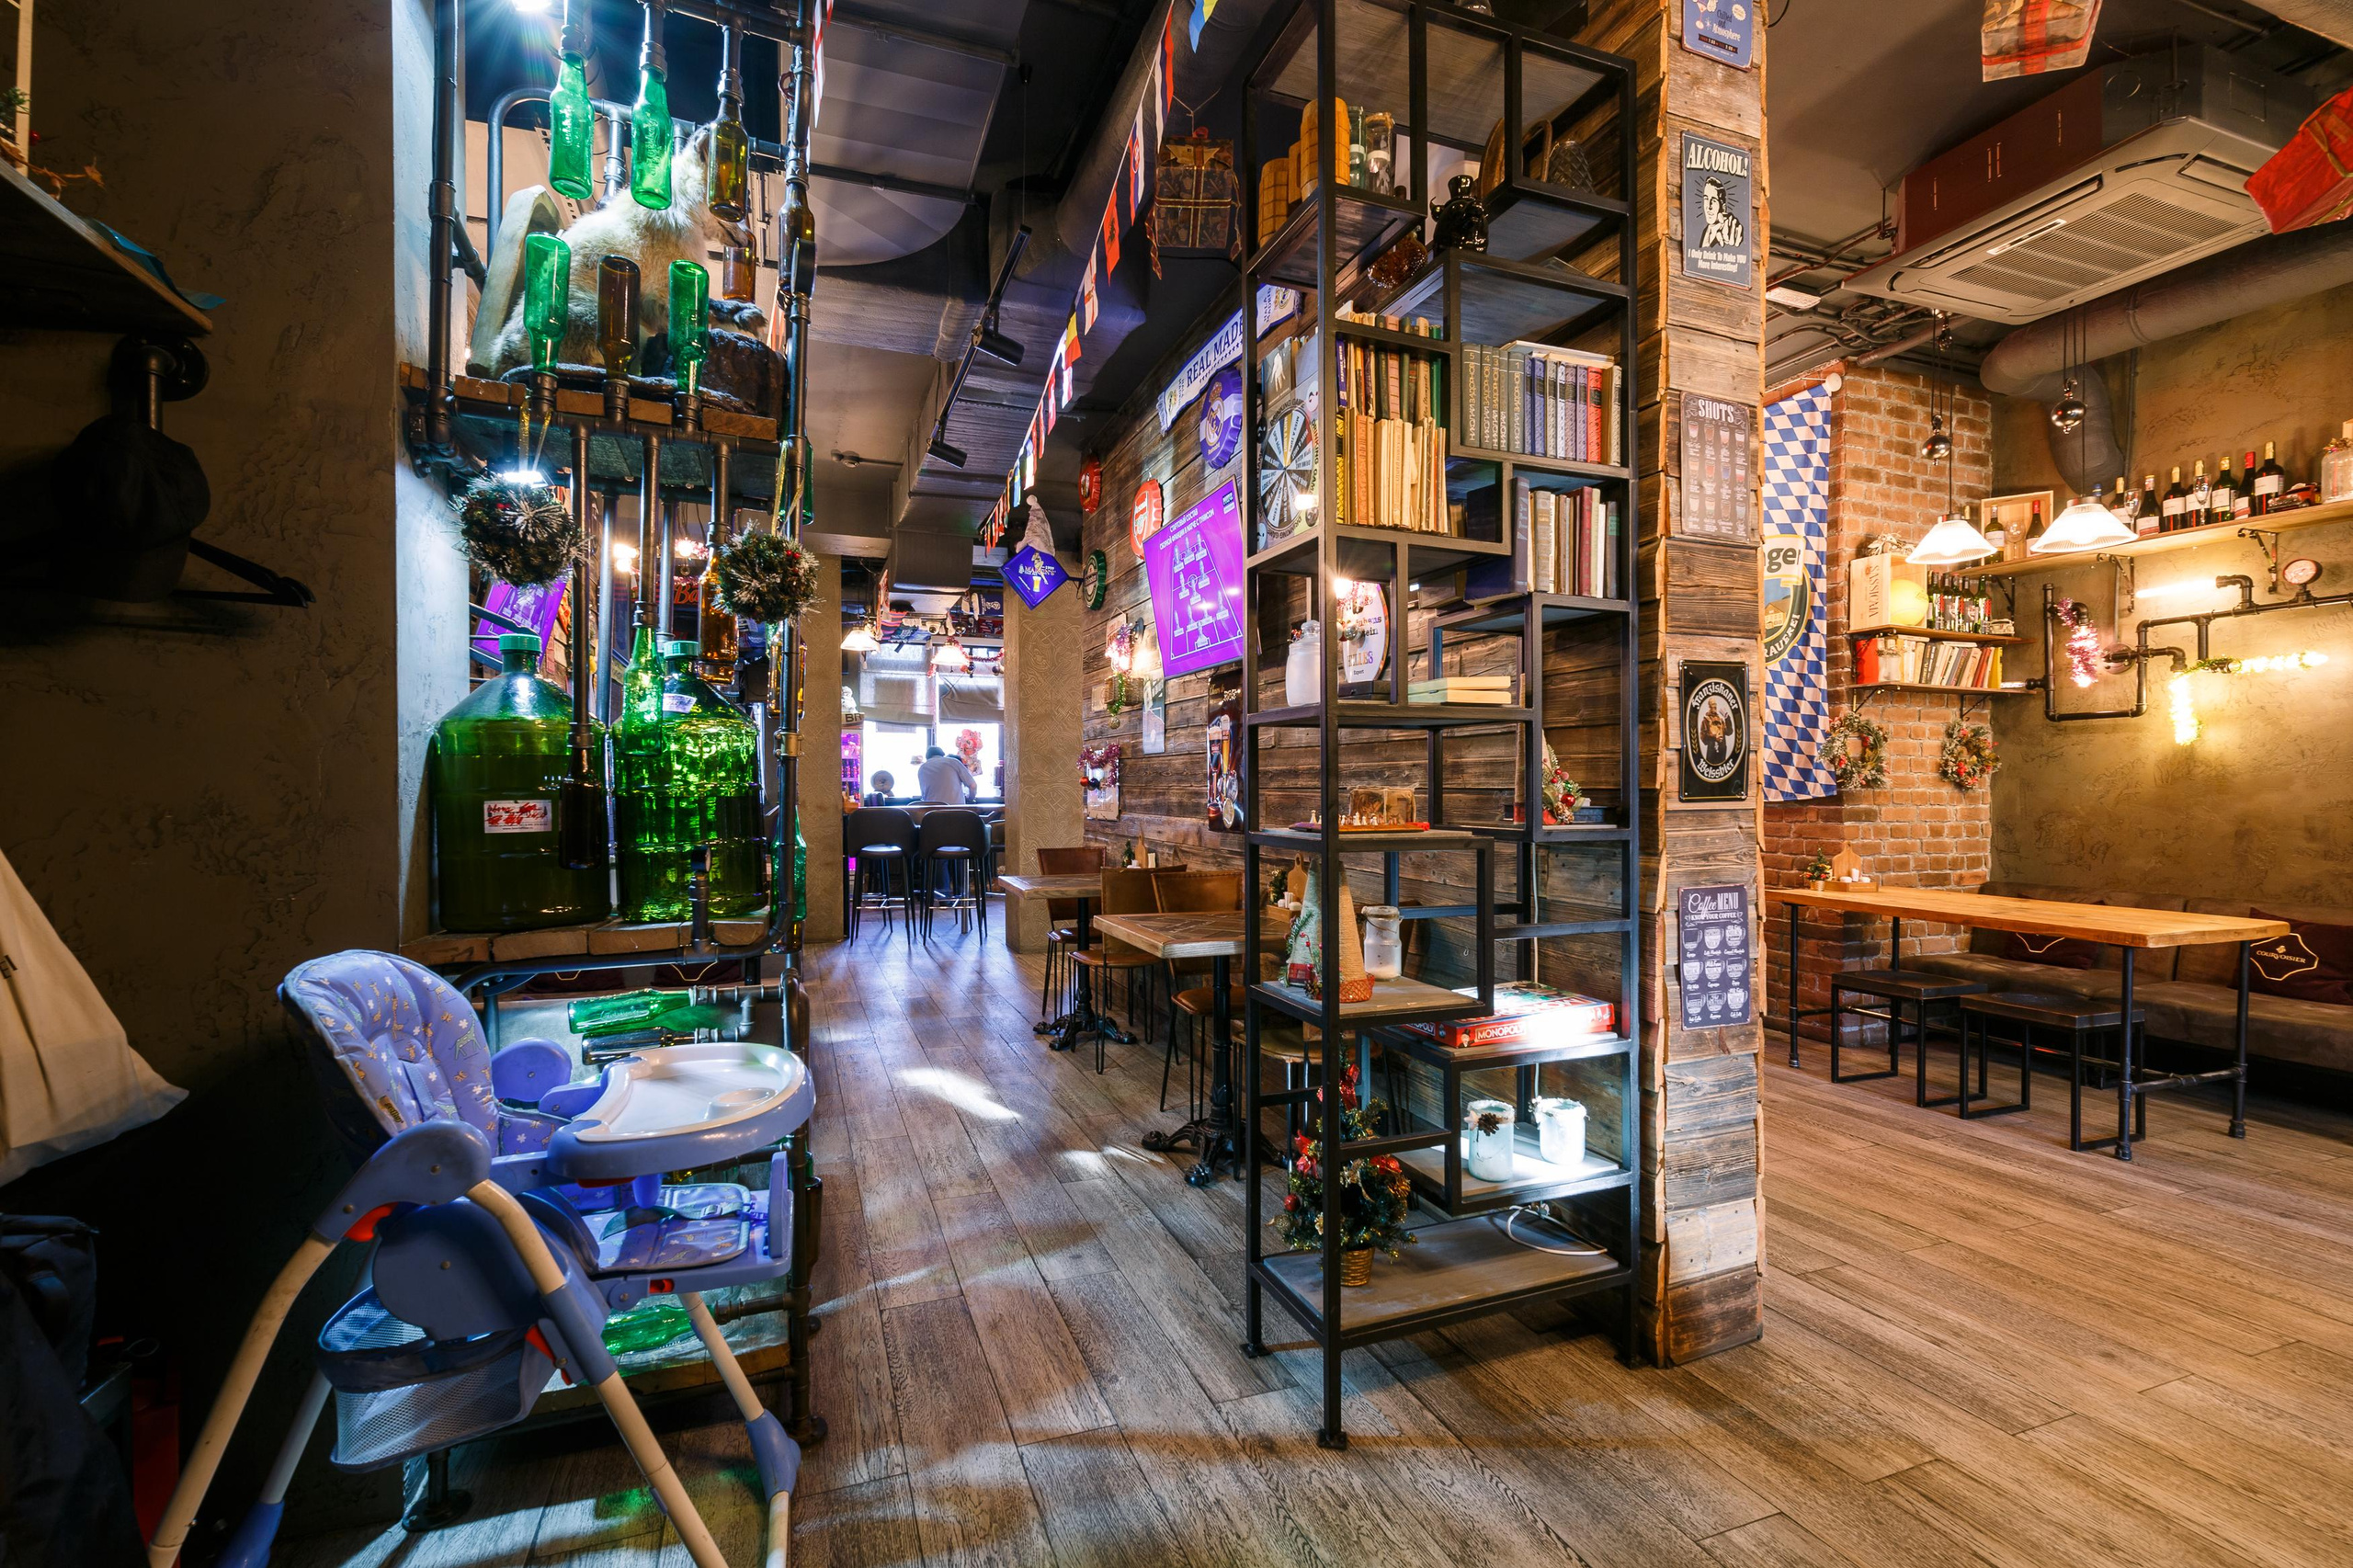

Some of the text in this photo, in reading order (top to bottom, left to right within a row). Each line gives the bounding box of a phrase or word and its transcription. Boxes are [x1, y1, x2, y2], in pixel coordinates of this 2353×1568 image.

[1712, 23, 1741, 41] Atmosphere
[1687, 142, 1748, 177] ALCOHOL!
[1691, 249, 1702, 260] Only
[1703, 250, 1717, 261] Drink
[1717, 252, 1722, 261] To
[1723, 253, 1736, 263] Make
[1736, 254, 1746, 264] YOU
[1698, 259, 1711, 269] More
[1470, 352, 1475, 360] 5
[1484, 355, 1490, 363] 4
[1493, 358, 1499, 367] 3
[1187, 349, 1212, 388] REAL
[1516, 361, 1520, 369] 1
[1698, 399, 1734, 423] SHOTS
[1869, 565, 1879, 618] SASSICAIA
[1691, 682, 1739, 711] Franziskaner
[1697, 758, 1734, 779] Weissbier
[1688, 892, 1739, 917] Coffee MENU
[2256, 949, 2306, 964] COURVOISIER
[1476, 1024, 1526, 1040] MONOPOLY
